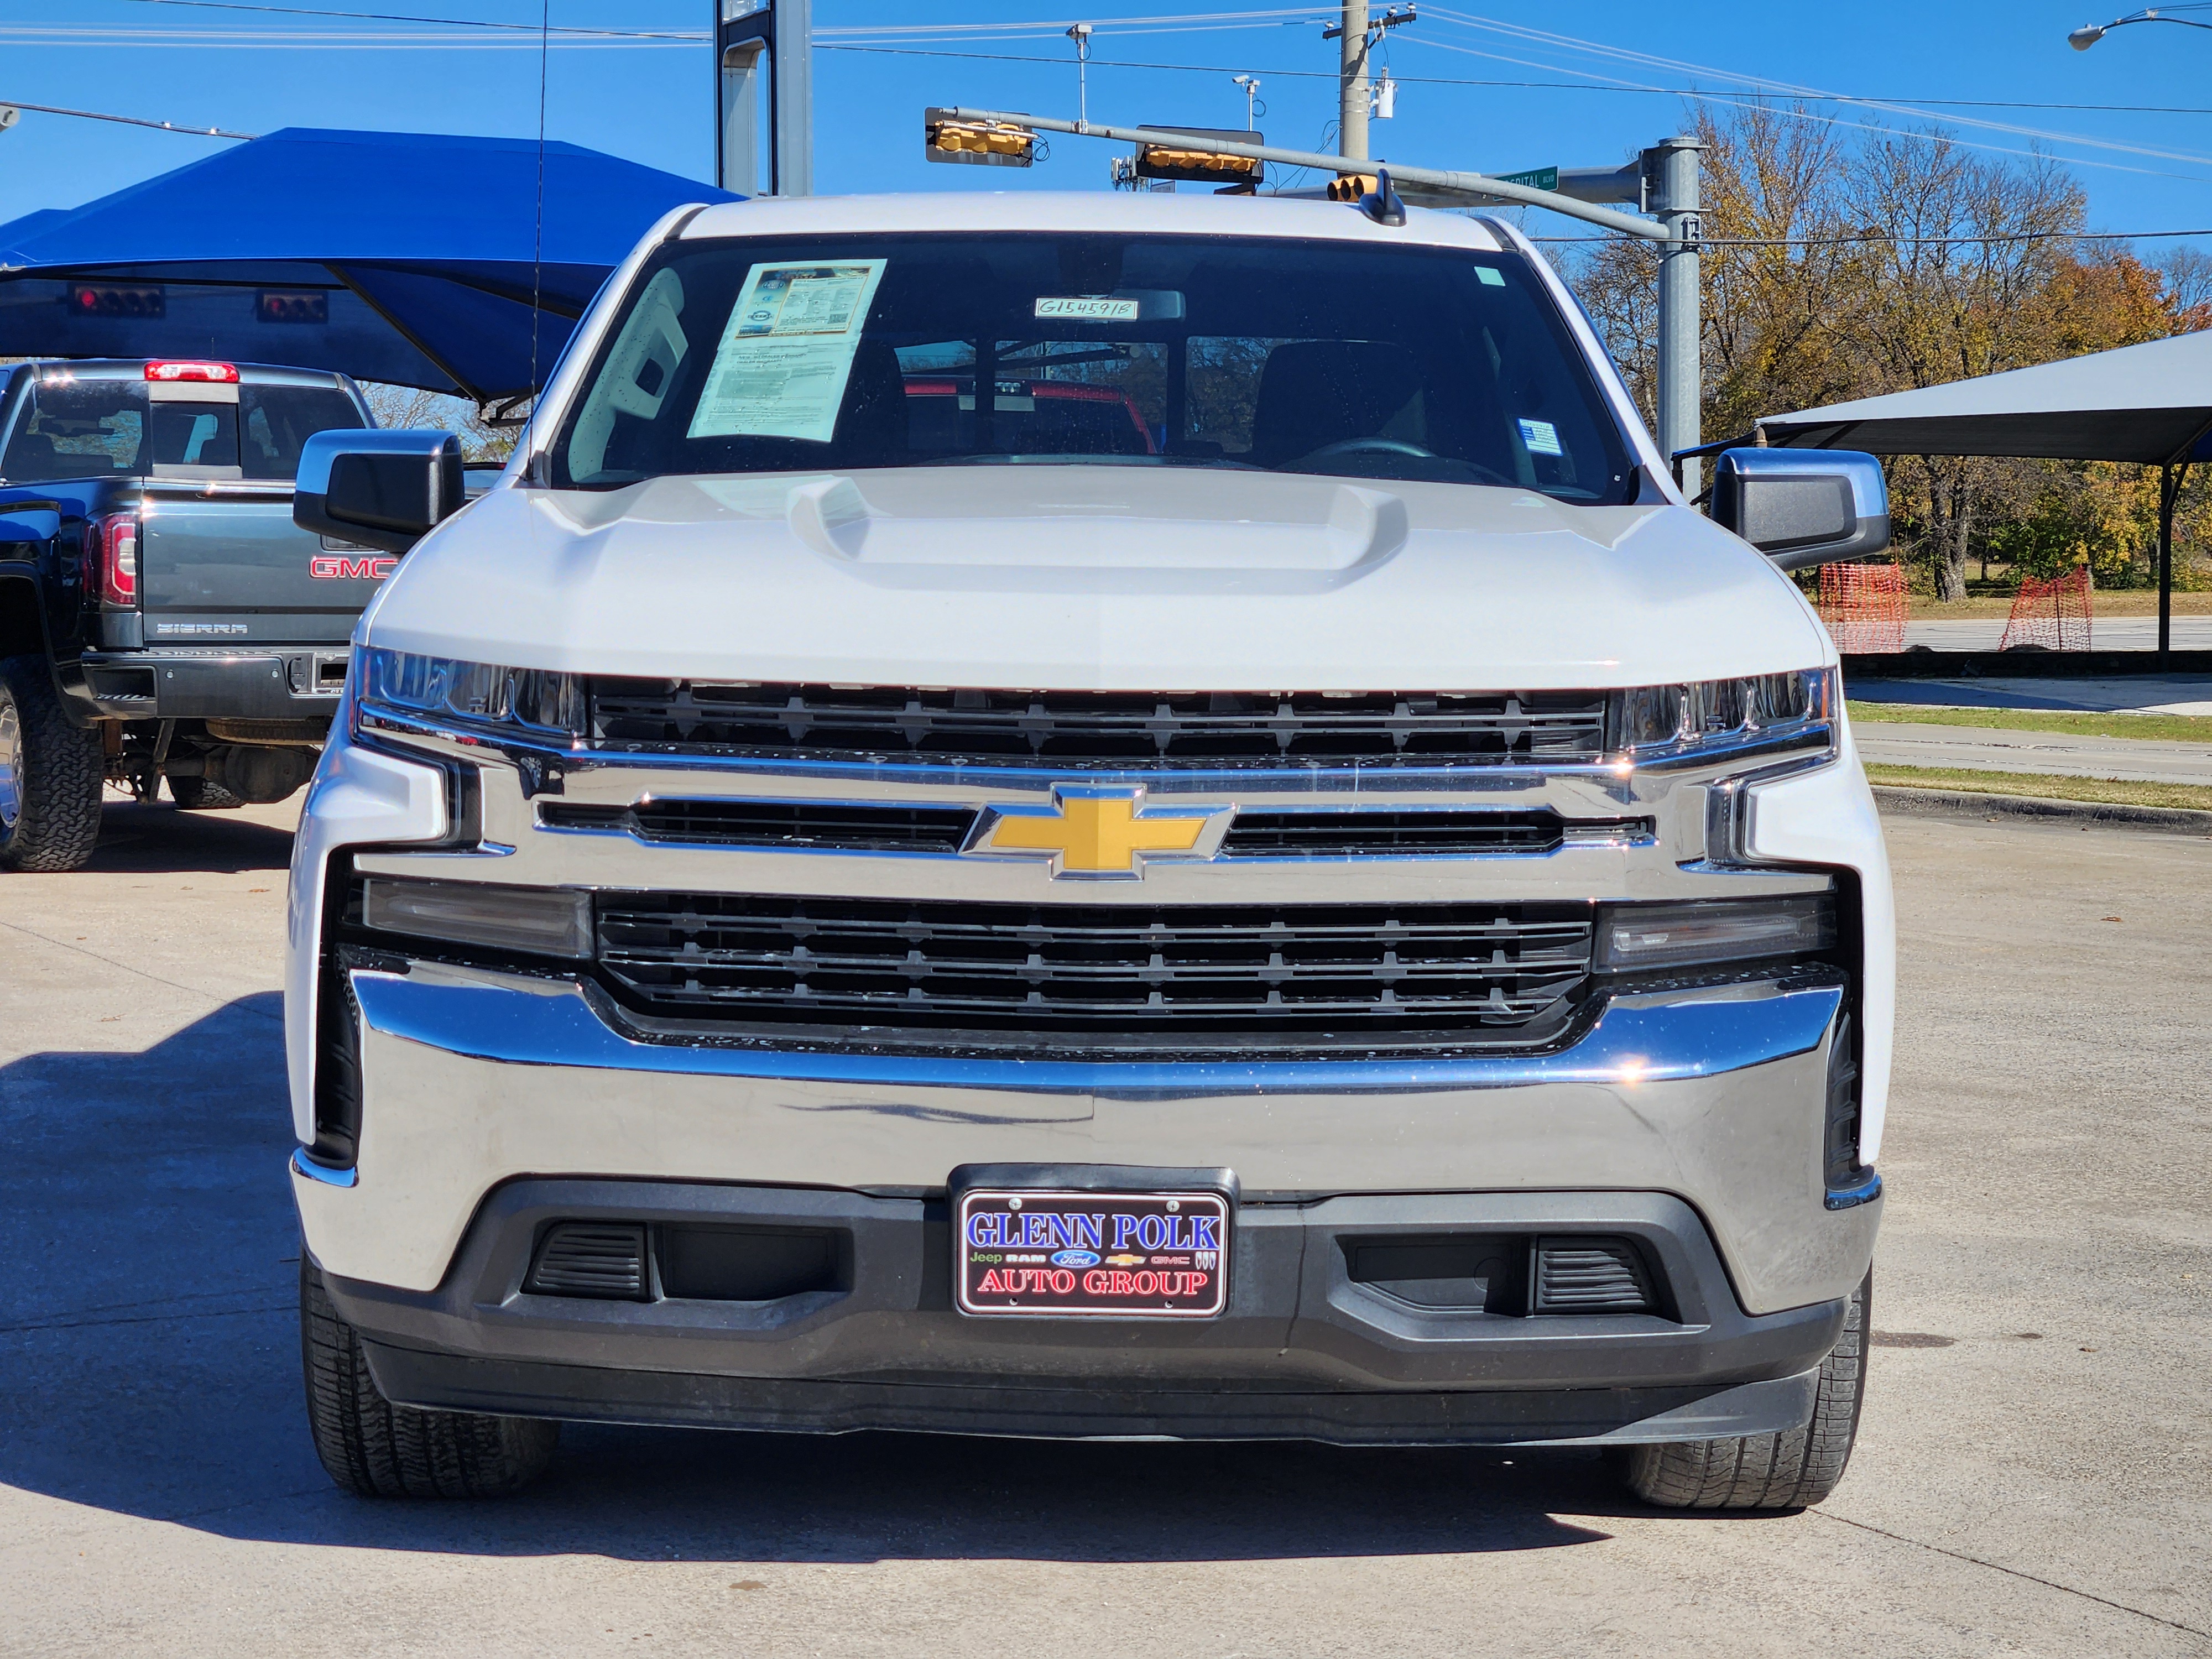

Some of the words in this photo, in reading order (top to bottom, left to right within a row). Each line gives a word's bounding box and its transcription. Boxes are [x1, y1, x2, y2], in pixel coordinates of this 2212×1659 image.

[1505, 175, 1539, 187] PITAL
[1543, 175, 1554, 184] BLVD
[309, 556, 399, 580] GMC
[156, 623, 248, 634] SIERRA
[967, 1212, 1105, 1249] GLENN
[1111, 1214, 1220, 1250] POLK
[970, 1251, 1002, 1264] Jeep
[1005, 1255, 1046, 1263] RAM
[1059, 1253, 1092, 1266] Ford
[1151, 1256, 1190, 1265] GMC
[977, 1269, 1076, 1293] AUTO
[1083, 1270, 1208, 1295] GROUP
